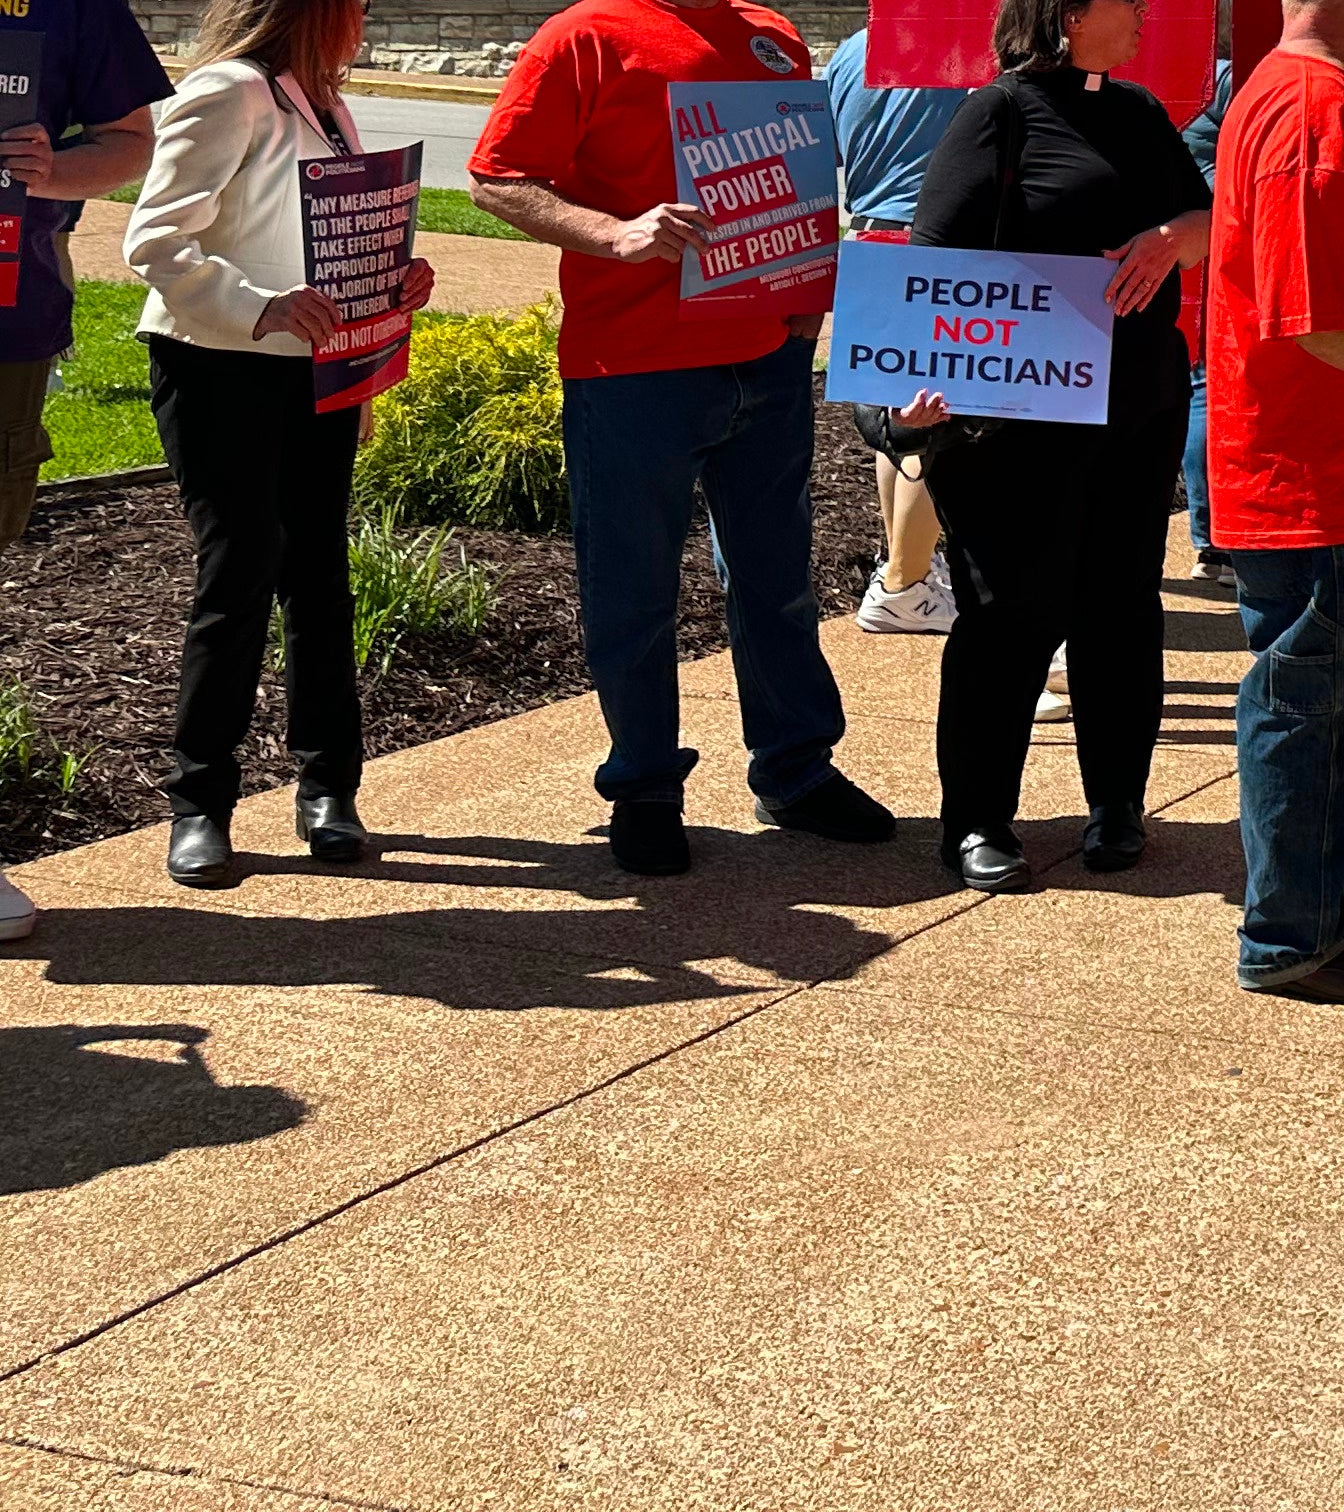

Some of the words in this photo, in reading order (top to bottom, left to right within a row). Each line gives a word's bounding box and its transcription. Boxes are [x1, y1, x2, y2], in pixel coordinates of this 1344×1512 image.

[675, 101, 728, 142] ALL
[682, 114, 820, 178] POLITICAL
[340, 189, 393, 212] MEASURE
[700, 164, 793, 217] POWER
[310, 220, 328, 238] TO
[330, 216, 353, 236] THE
[355, 207, 391, 231] PEOPLE
[740, 217, 751, 233] IN
[752, 213, 773, 231] AND
[772, 203, 809, 226] DERIVED
[809, 194, 835, 212] FROM
[312, 238, 345, 259] TAKE
[347, 232, 384, 254] EFFECT
[704, 242, 744, 277] THE
[745, 218, 822, 264] PEOPLE
[315, 254, 377, 281] APPROVED
[905, 276, 1053, 313] PEOPLE
[318, 331, 349, 356] AND
[350, 325, 373, 349] NOT
[933, 314, 1020, 347] NOT
[849, 343, 1093, 389] POLITICIANS
